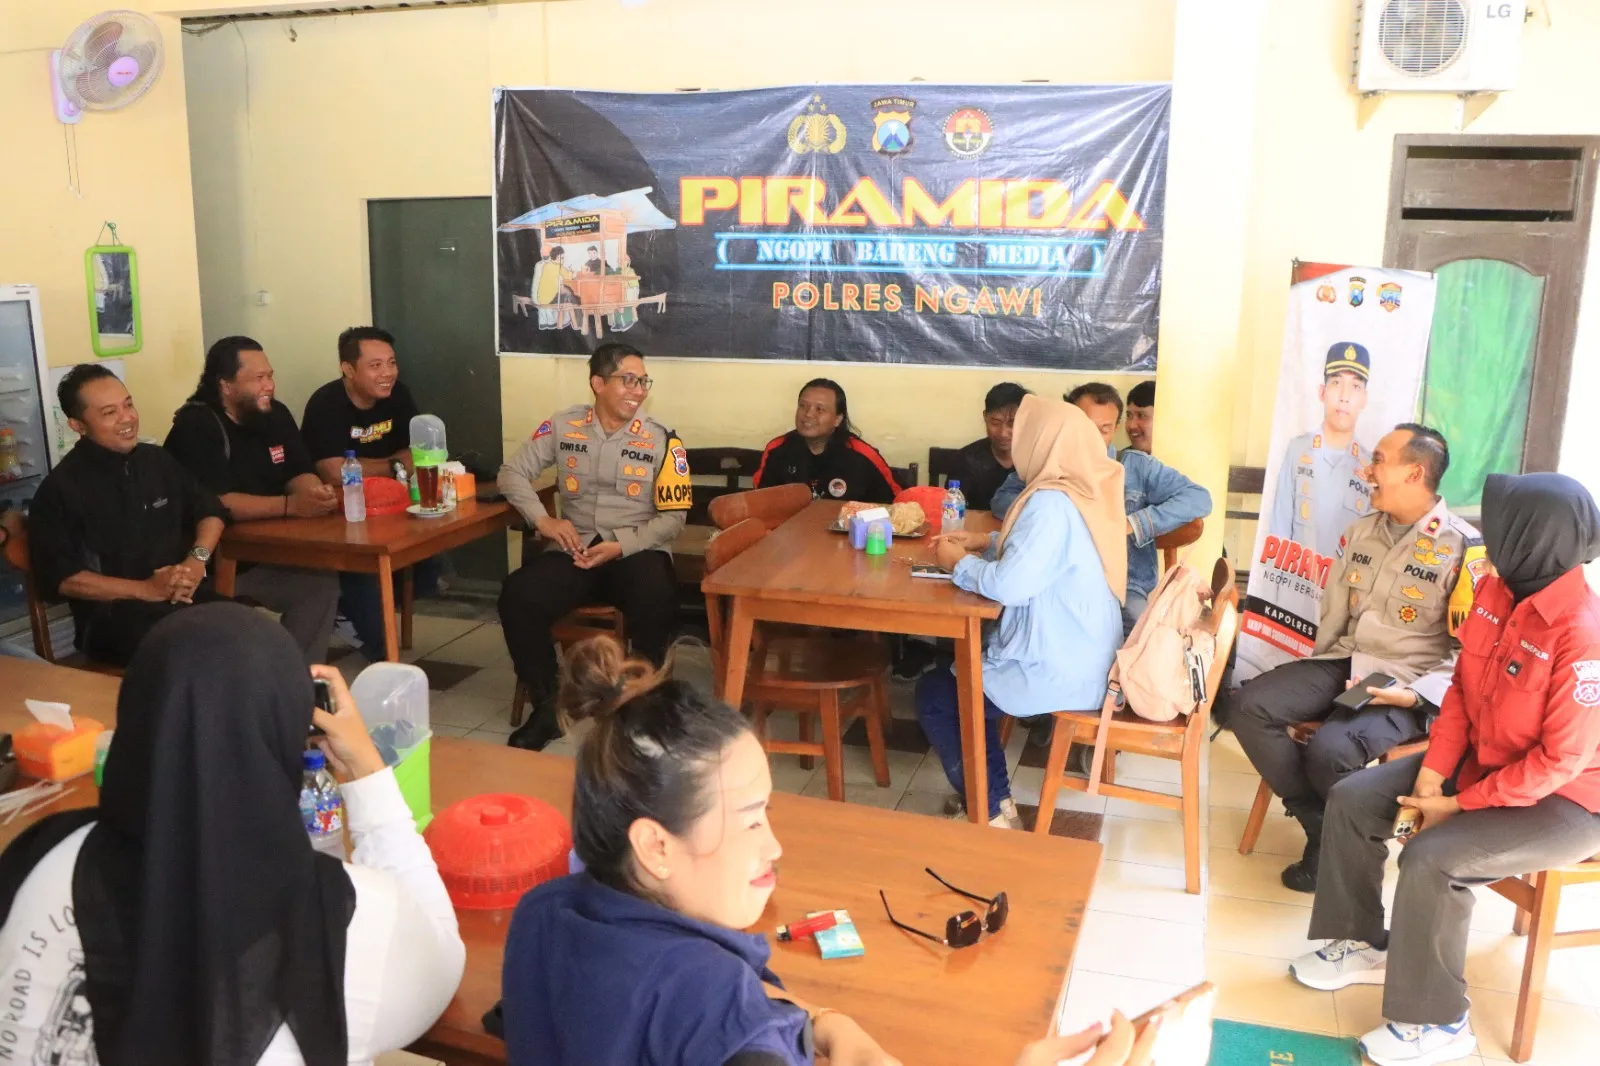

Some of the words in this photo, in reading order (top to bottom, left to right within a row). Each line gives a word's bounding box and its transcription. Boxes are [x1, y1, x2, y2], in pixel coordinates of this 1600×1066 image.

[1486, 4, 1512, 19] LG
[873, 98, 893, 108] JAWA
[893, 98, 915, 108] TIMUR
[679, 175, 1147, 231] PIRAMIDA
[546, 215, 600, 228] PIRAMIDA
[756, 239, 833, 262] NGOPI
[855, 240, 956, 265] BARENG
[985, 243, 1068, 267] MEDIA
[771, 281, 903, 313] POLRES
[914, 285, 1044, 317] NGAWI
[560, 441, 574, 452] DWI
[621, 449, 654, 463] POLRI
[658, 485, 674, 503] KA
[1263, 570, 1291, 588] NGOPI
[1404, 564, 1438, 584] POLRI
[1264, 605, 1313, 636] KAPOLRES
[1476, 607, 1499, 625] DIAN
[22, 931, 48, 959] IS
[3, 968, 32, 1022] ROAD
[0, 1030, 18, 1061] NO
